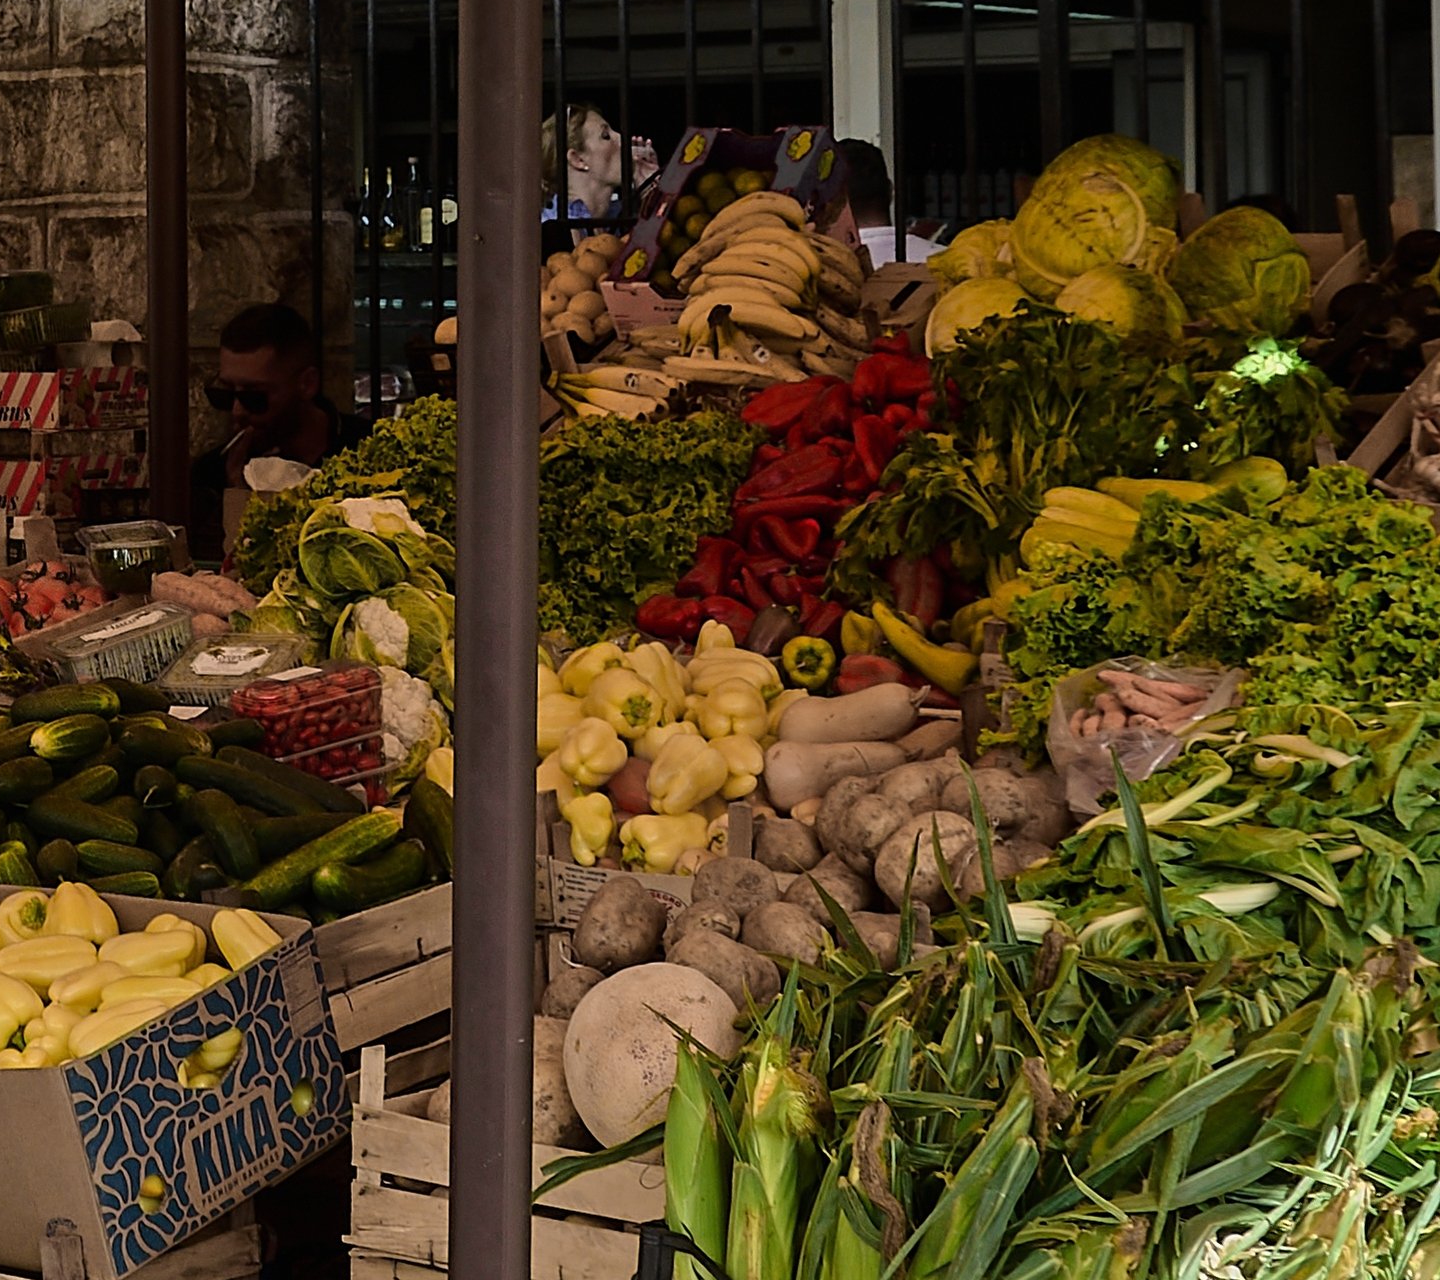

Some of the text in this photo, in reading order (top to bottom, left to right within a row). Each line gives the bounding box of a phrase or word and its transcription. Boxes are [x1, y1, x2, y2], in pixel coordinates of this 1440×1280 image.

[192, 1095, 277, 1195] KIKA
[201, 1151, 280, 1208] PREMIUM BANANAS
